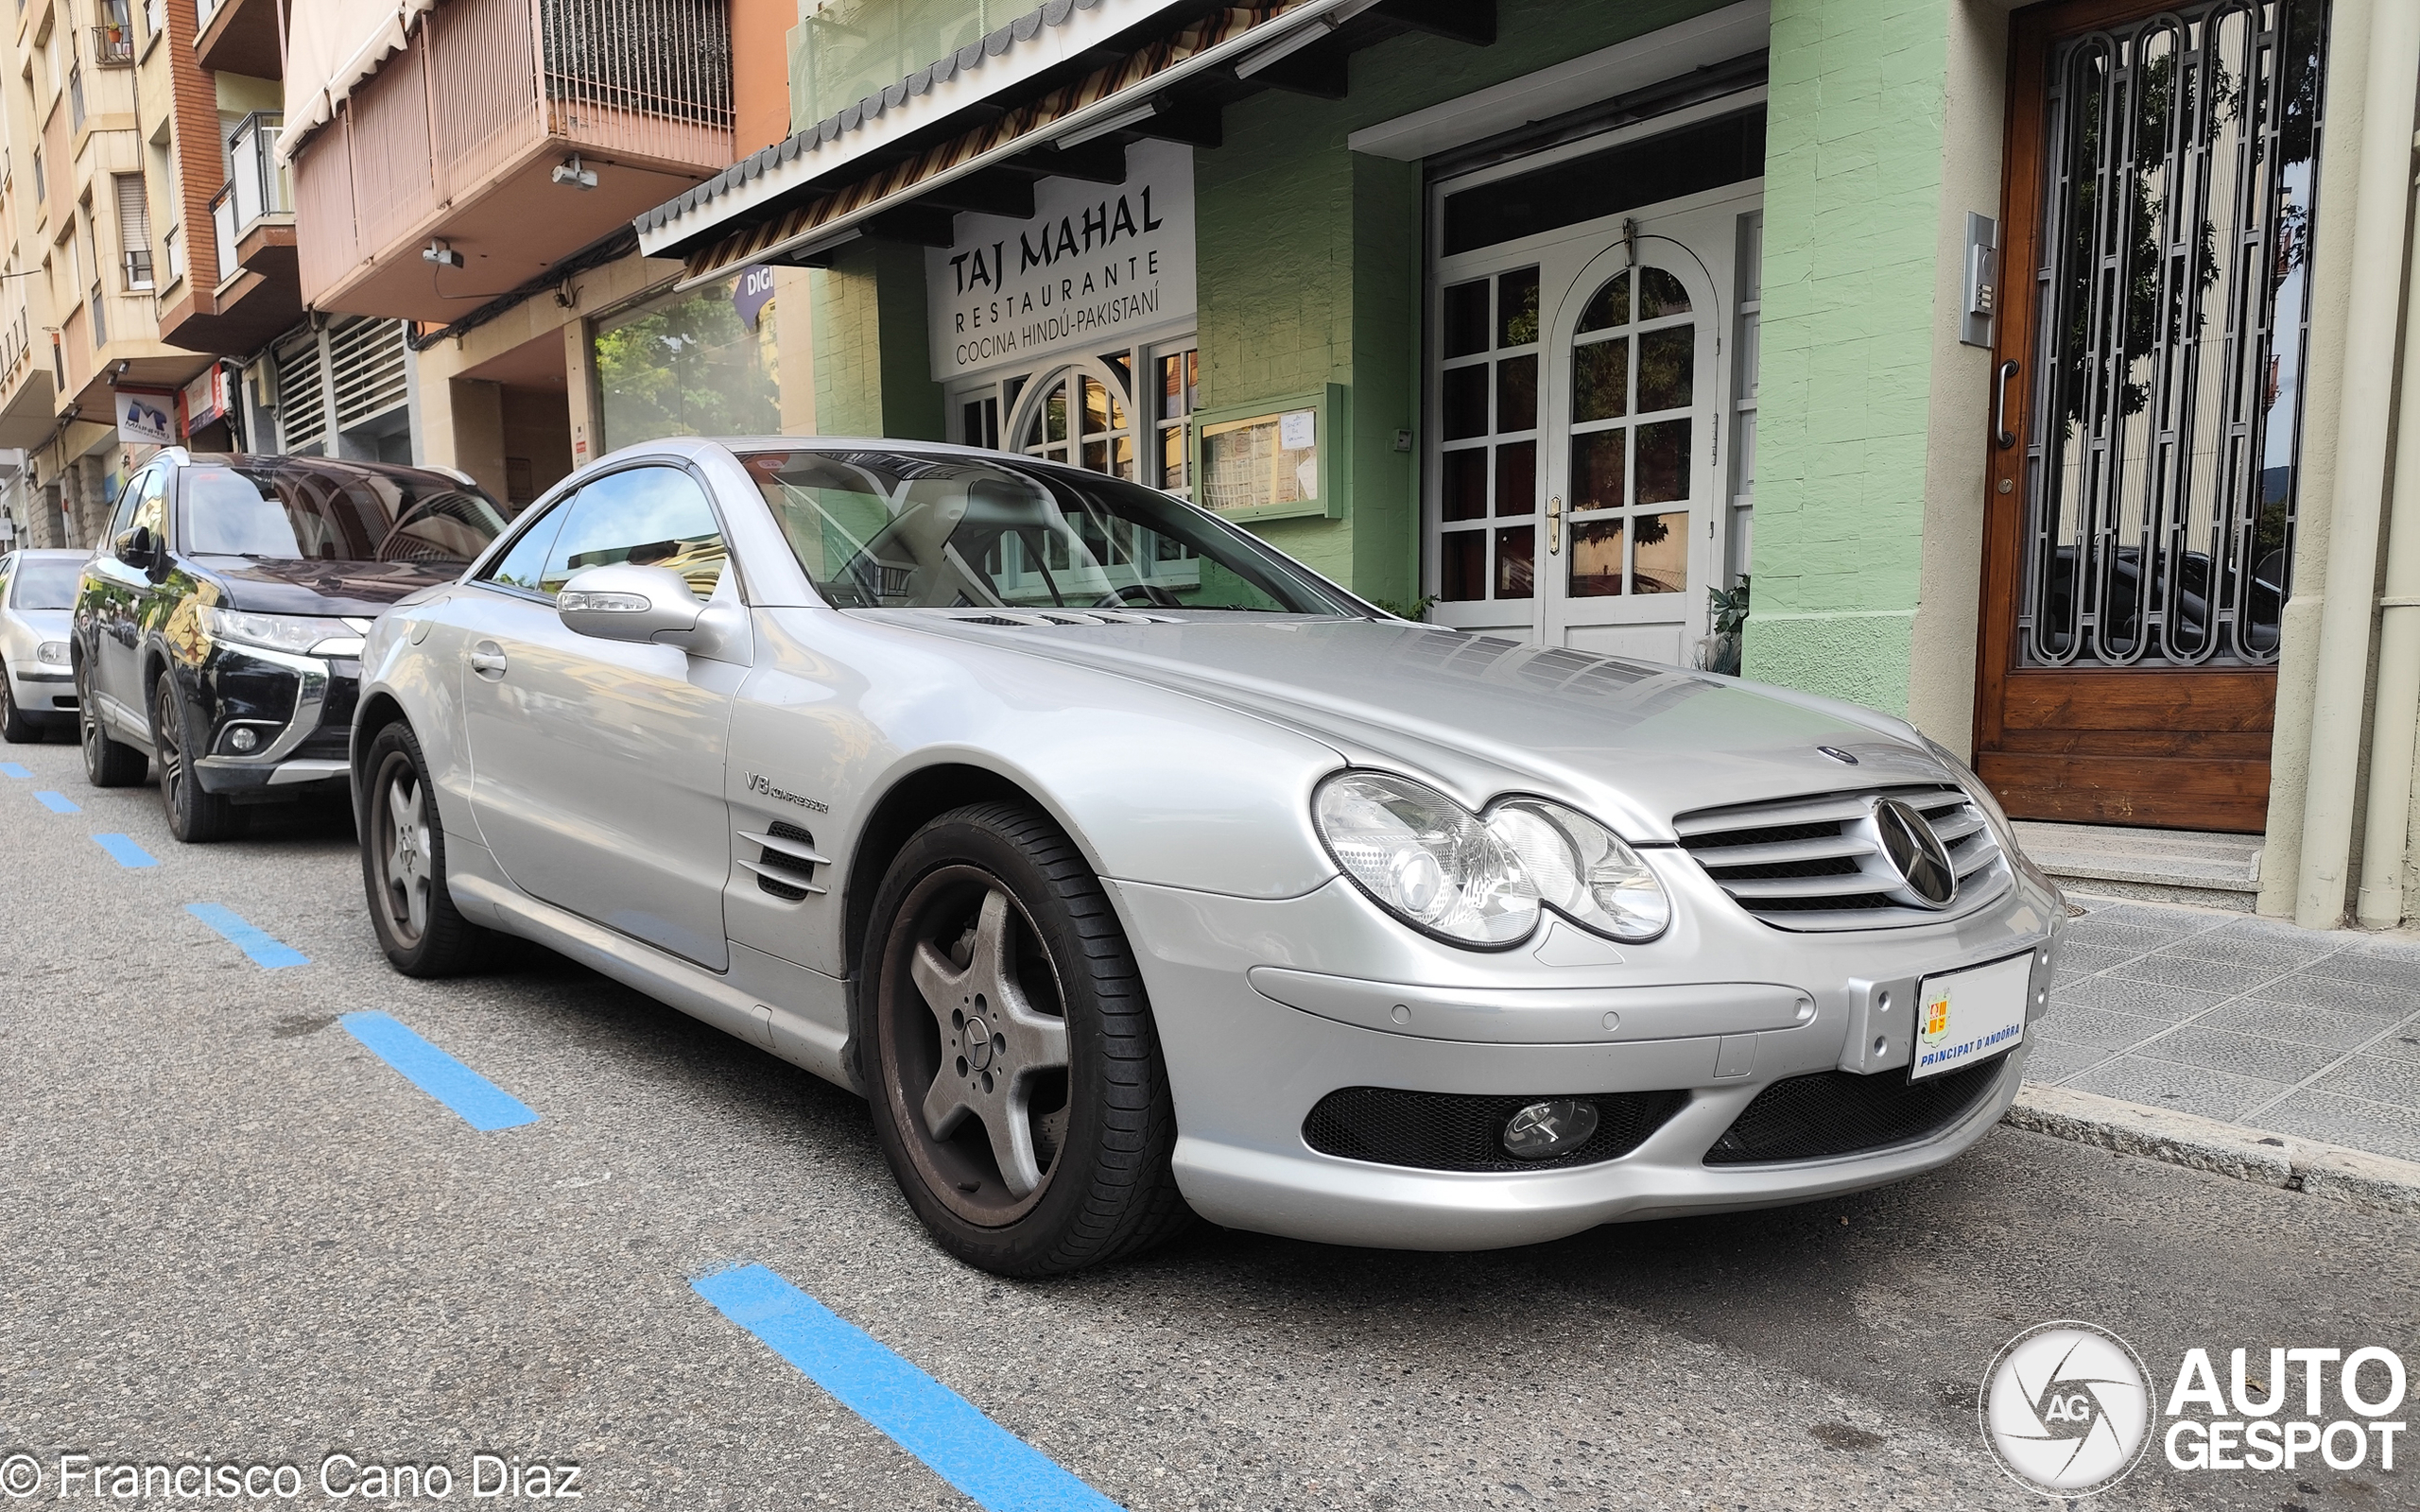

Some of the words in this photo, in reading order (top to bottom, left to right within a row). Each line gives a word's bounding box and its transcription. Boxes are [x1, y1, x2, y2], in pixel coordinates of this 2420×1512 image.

[949, 240, 1005, 297] TAJ
[1019, 184, 1164, 276] MAHAL
[955, 249, 1159, 334] RESTAURANTE
[956, 331, 1017, 366] COCINA
[1022, 281, 1160, 349] HINDÚ-PAKISTANÍ
[744, 771, 770, 795] V8
[770, 786, 829, 815] KOMPRESSOR
[1921, 1041, 1975, 1067] PRINCIPAT
[1977, 1024, 2020, 1050] D'ANDORRA
